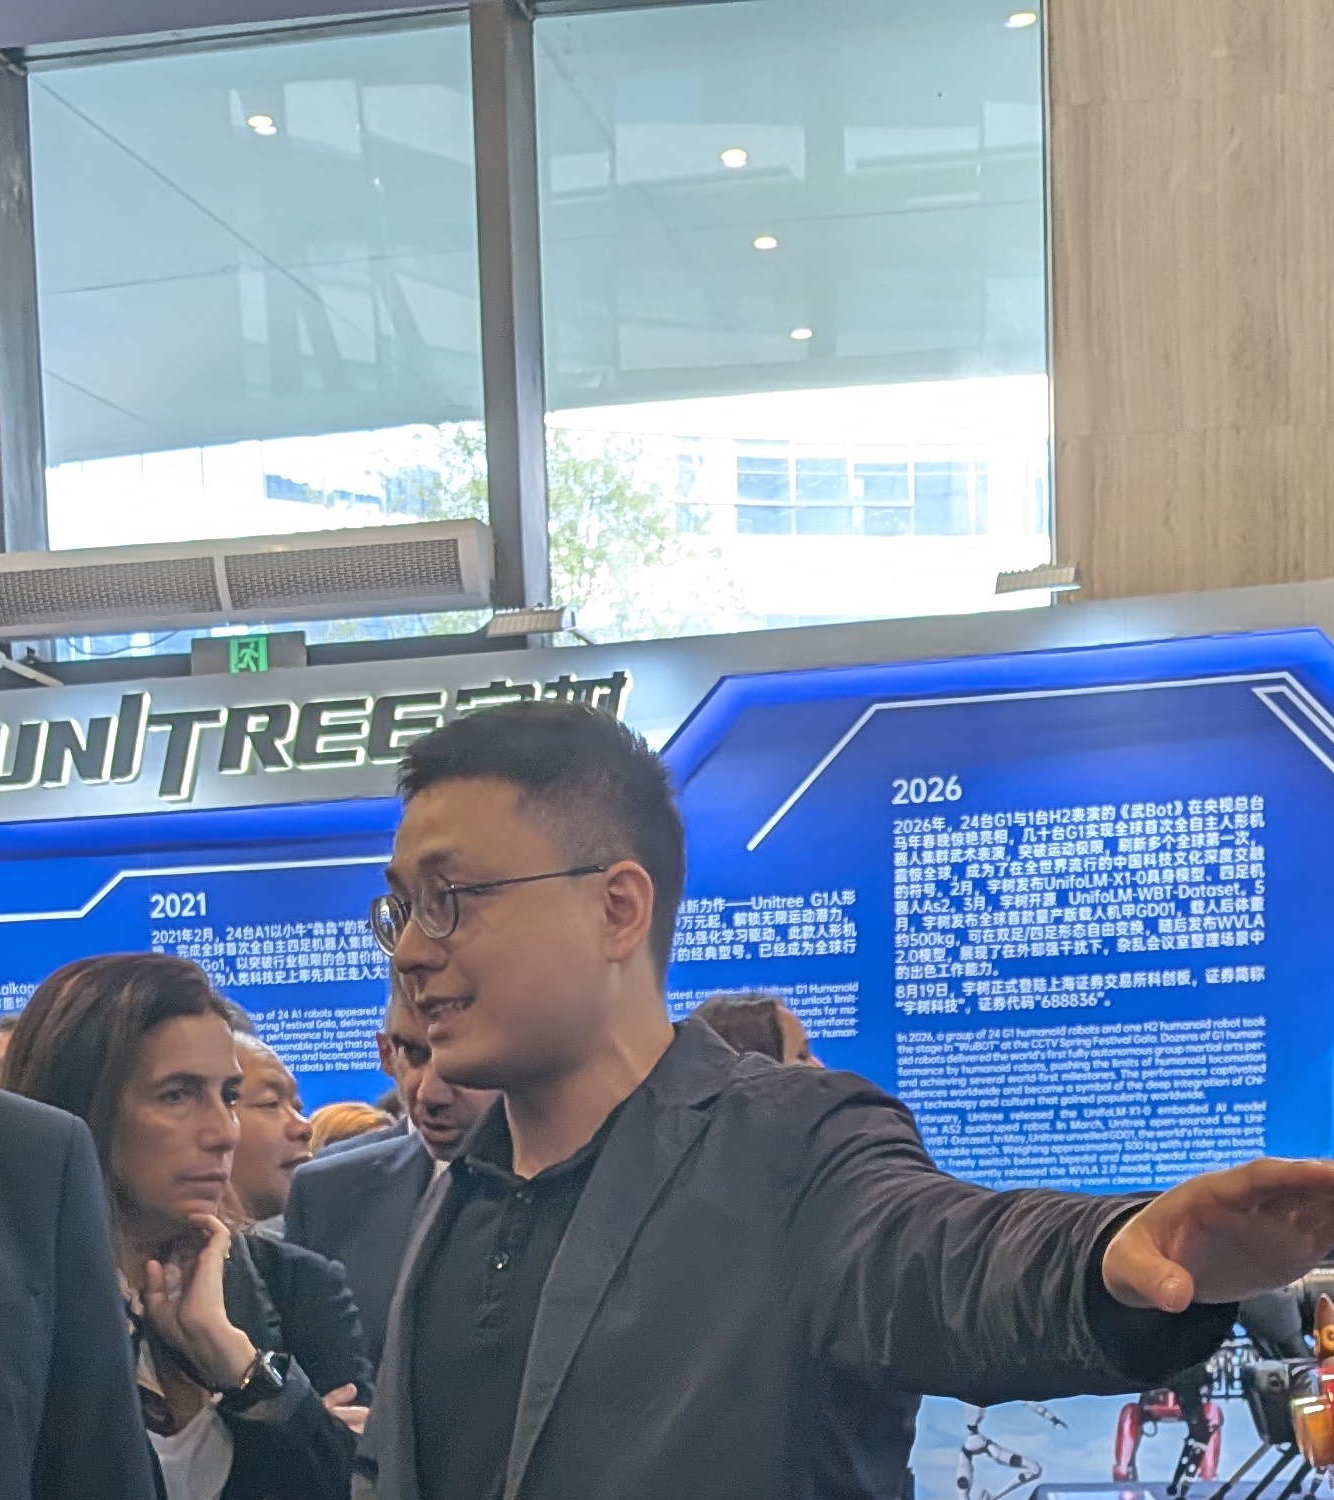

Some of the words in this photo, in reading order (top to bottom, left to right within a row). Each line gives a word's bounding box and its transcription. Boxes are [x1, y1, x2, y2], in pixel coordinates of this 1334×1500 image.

[891, 775, 962, 805] 2026
[150, 892, 207, 919] 2021
[1016, 1025, 1066, 1038] humanoid
[1068, 1024, 1100, 1035] robots
[1102, 1023, 1121, 1034] and
[1160, 1019, 1211, 1031] humanoid
[1213, 1017, 1241, 1028] robot
[1243, 1016, 1266, 1027] took
[1031, 1038, 1059, 1049] CCTV
